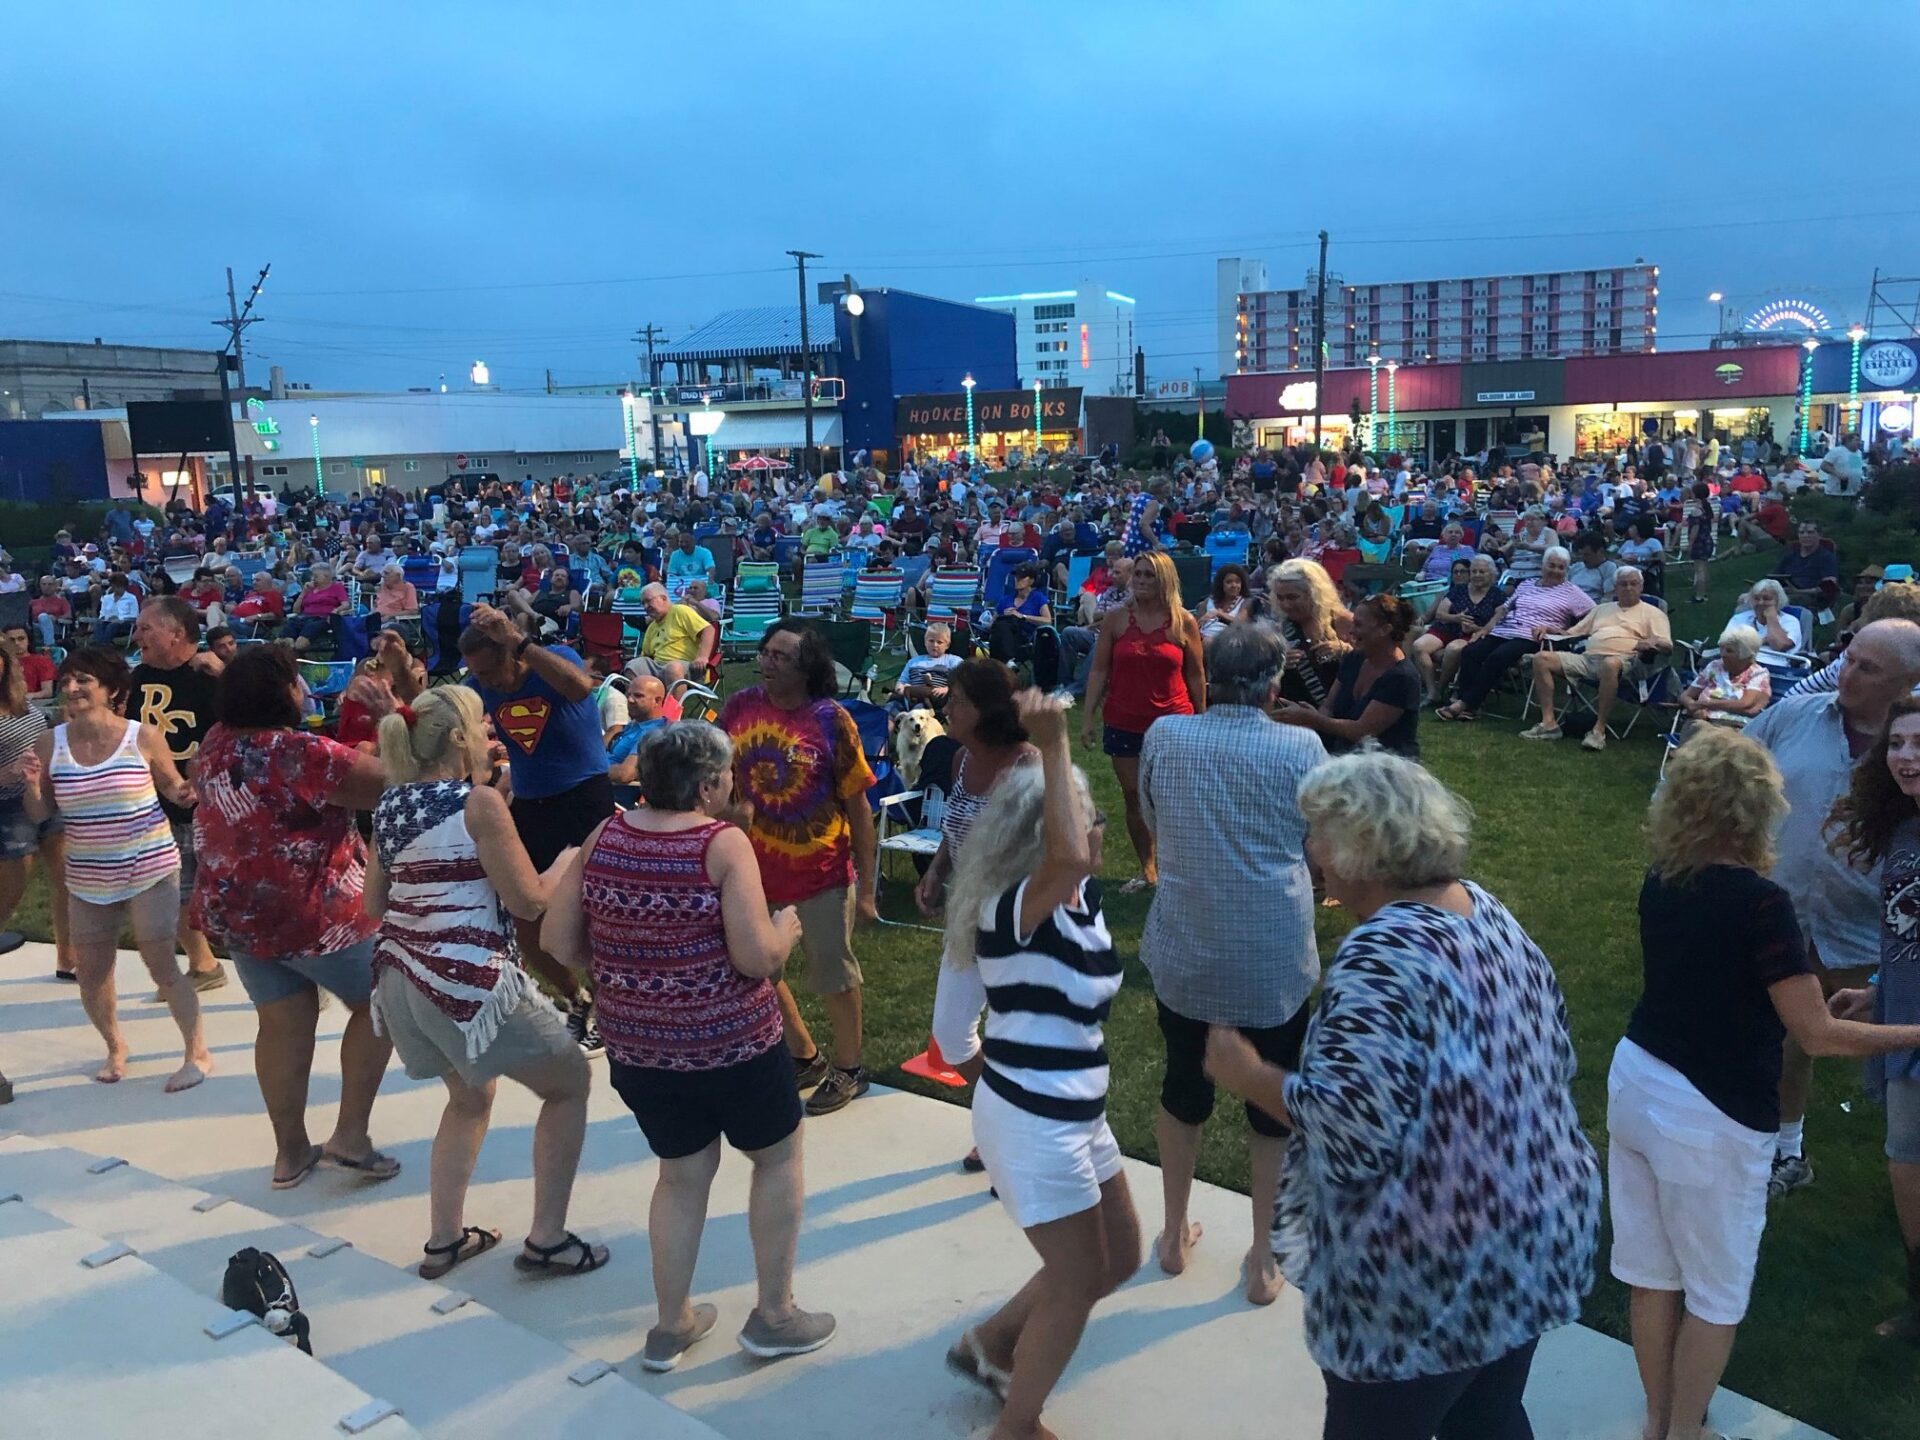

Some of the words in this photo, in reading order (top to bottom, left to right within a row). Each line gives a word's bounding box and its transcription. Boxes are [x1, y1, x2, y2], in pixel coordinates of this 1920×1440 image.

[680, 391, 698, 400] BUD
[699, 389, 723, 399] LIHT
[981, 405, 1002, 420] ON
